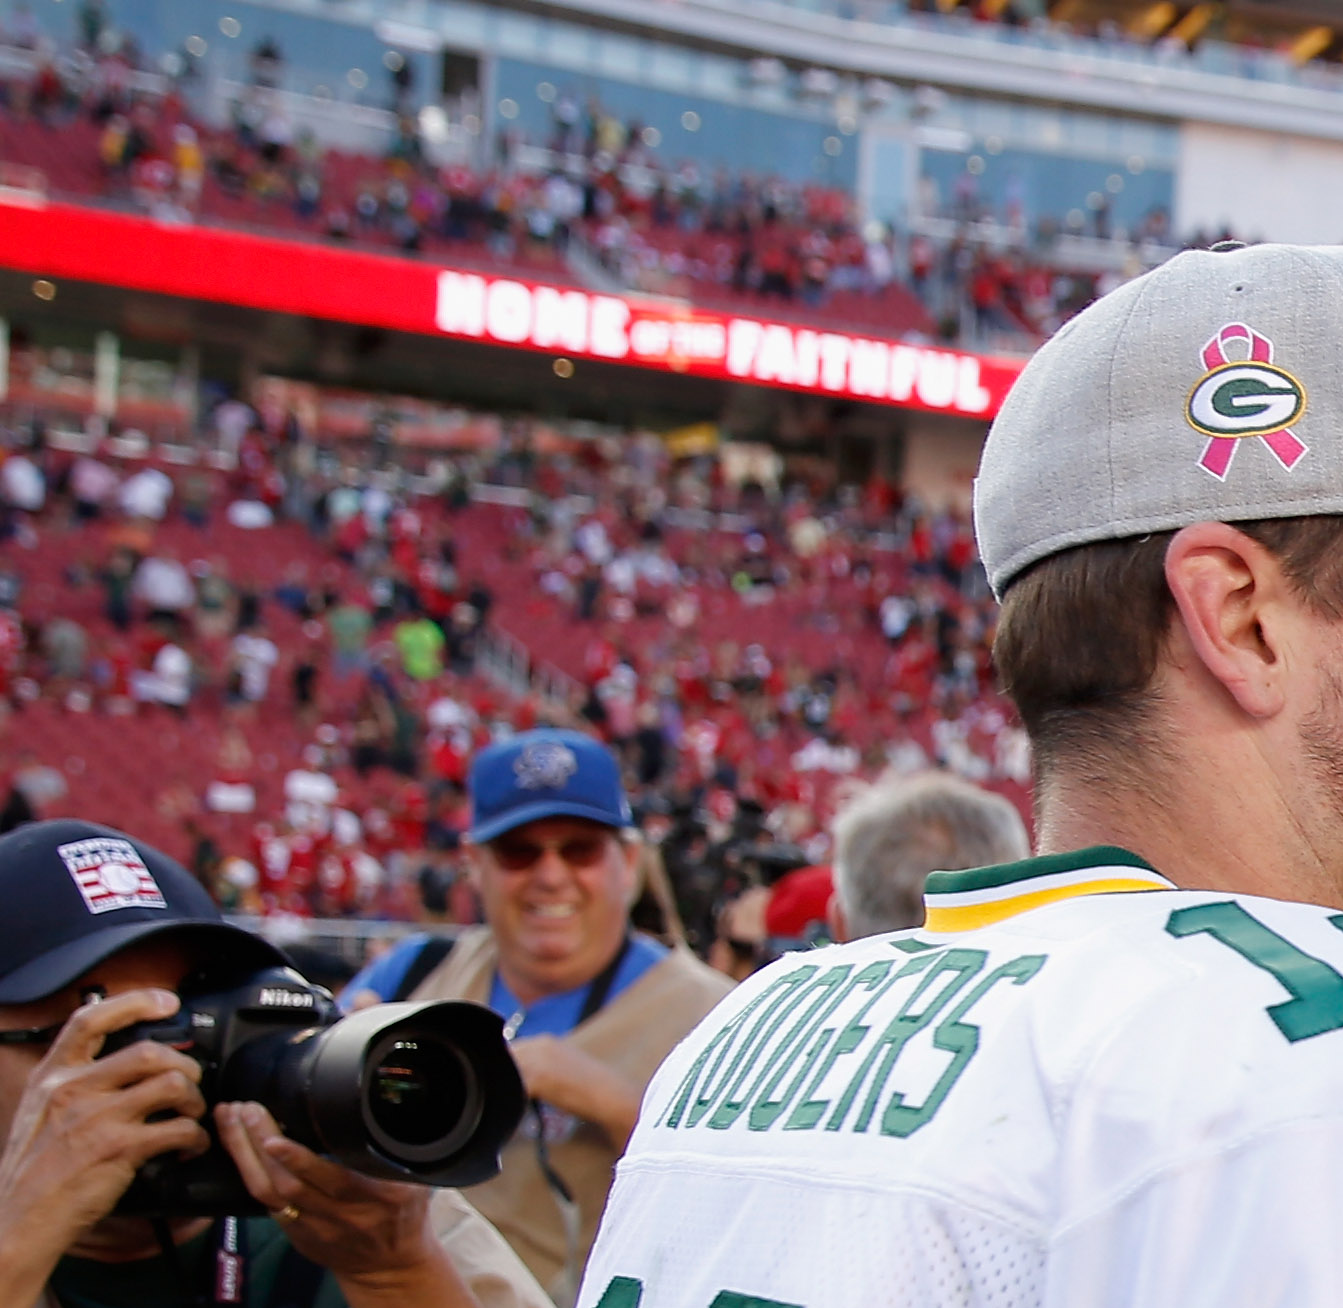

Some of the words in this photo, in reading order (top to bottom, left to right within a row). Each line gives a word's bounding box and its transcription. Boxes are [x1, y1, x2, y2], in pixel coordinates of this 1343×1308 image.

[436, 271, 631, 360] HOME
[727, 319, 992, 414] FAITHFUL
[1188, 364, 1303, 422] G
[260, 988, 314, 1007] Nikon
[654, 948, 1049, 1138] RODGERS
